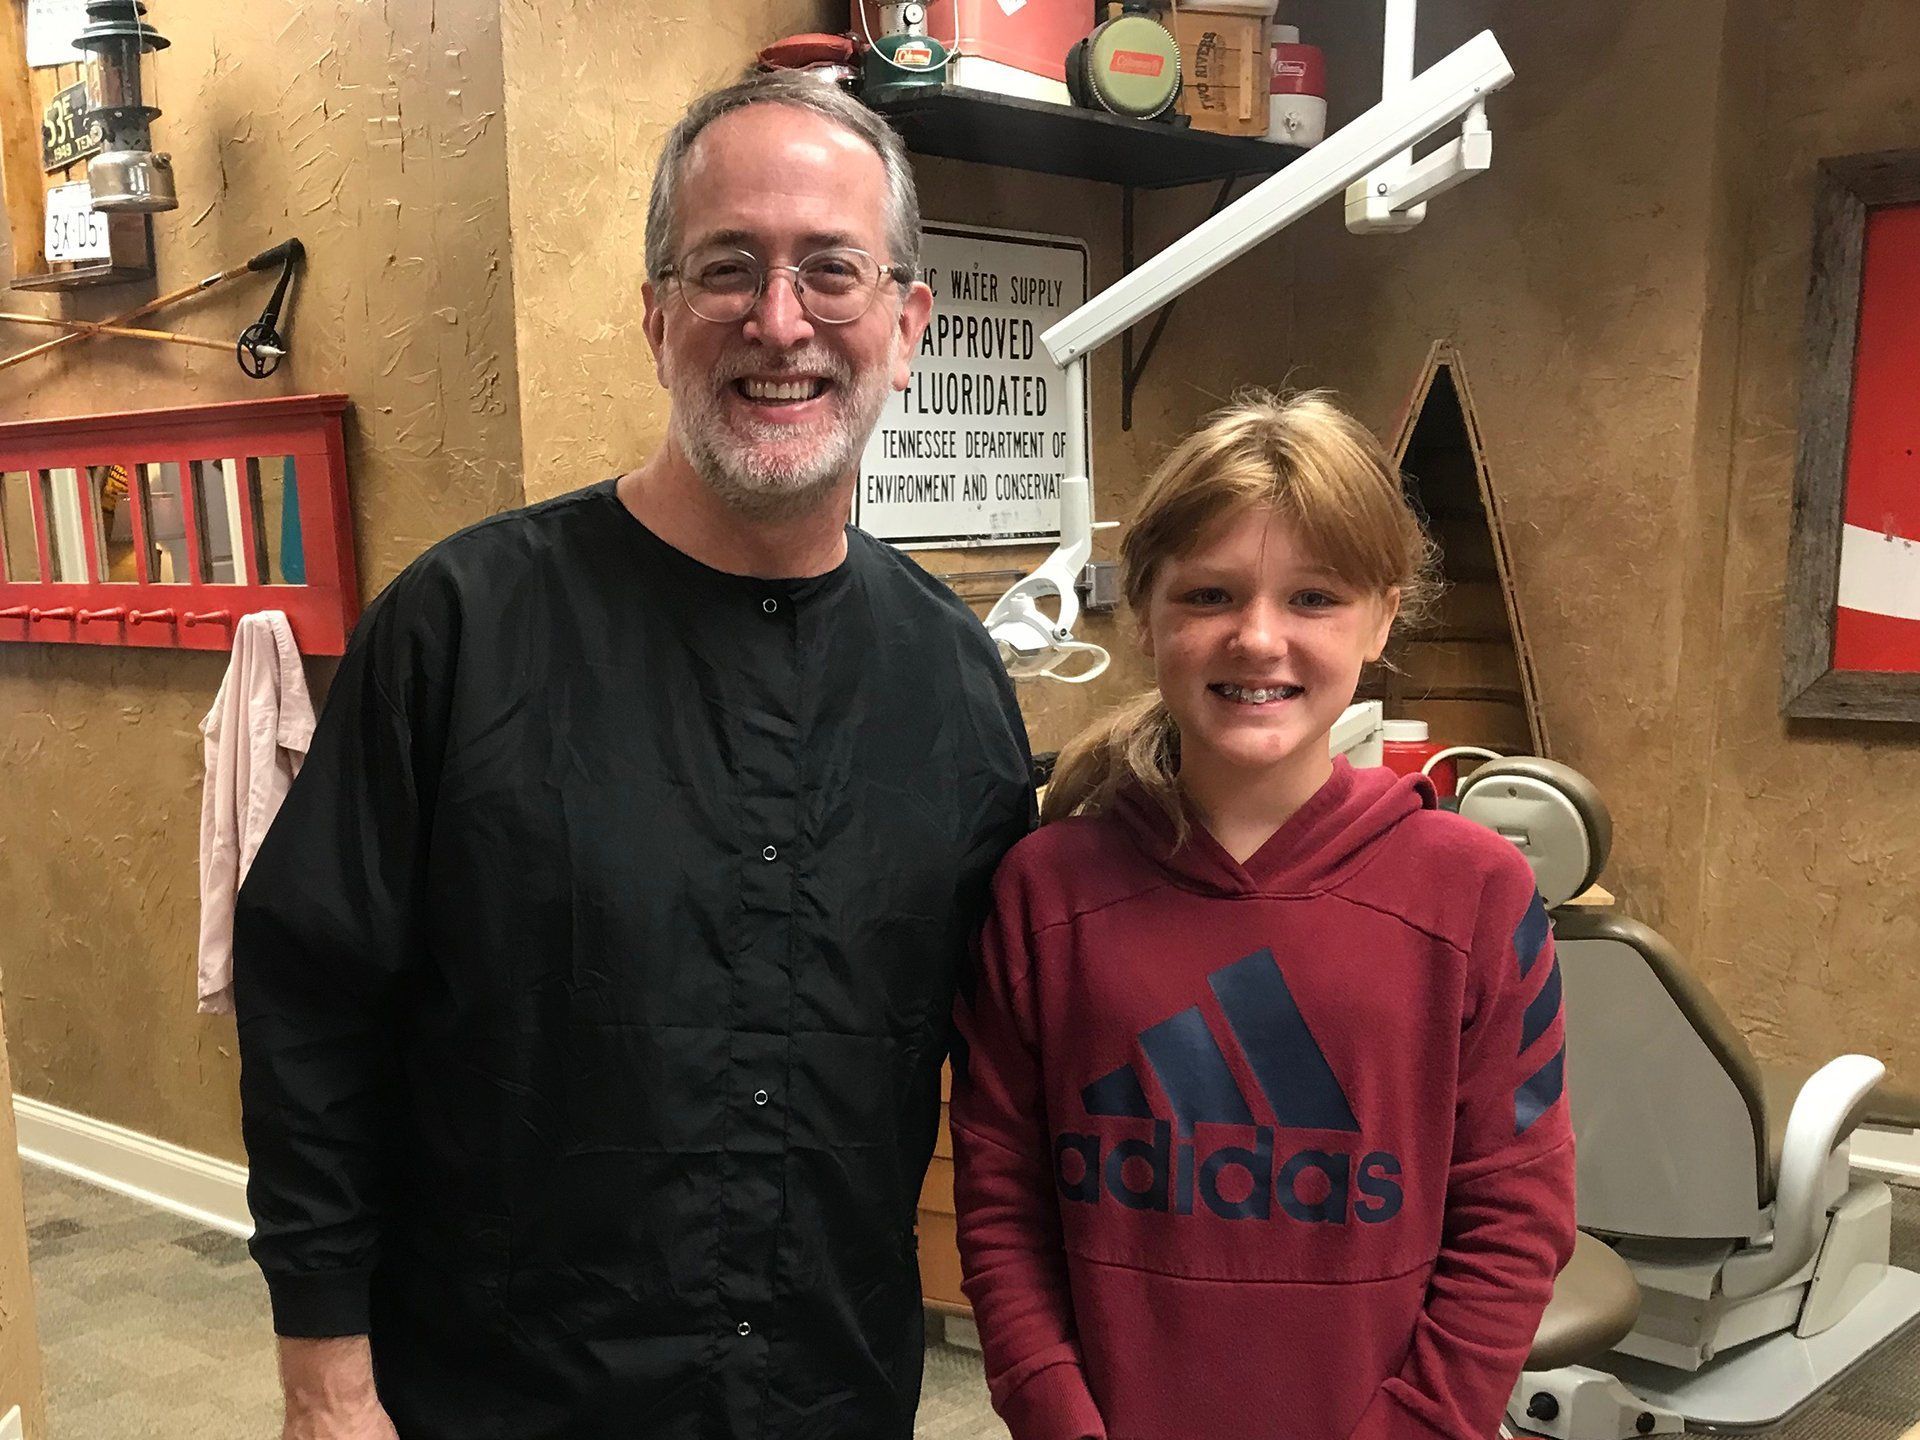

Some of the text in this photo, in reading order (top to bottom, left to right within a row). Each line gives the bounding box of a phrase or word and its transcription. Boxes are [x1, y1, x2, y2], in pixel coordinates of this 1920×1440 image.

[1195, 32, 1217, 78] RIVERS
[923, 268, 1063, 307] IC WATER SUPPLY
[921, 314, 1034, 360] APPROVED
[904, 371, 1047, 416] FLUORIDATED
[882, 430, 1066, 458] TENNESSEE DEPARTMENT OF
[867, 473, 1065, 504] ENVIRONMENT AND CONSERVAT
[1055, 1119, 1404, 1224] adidas
